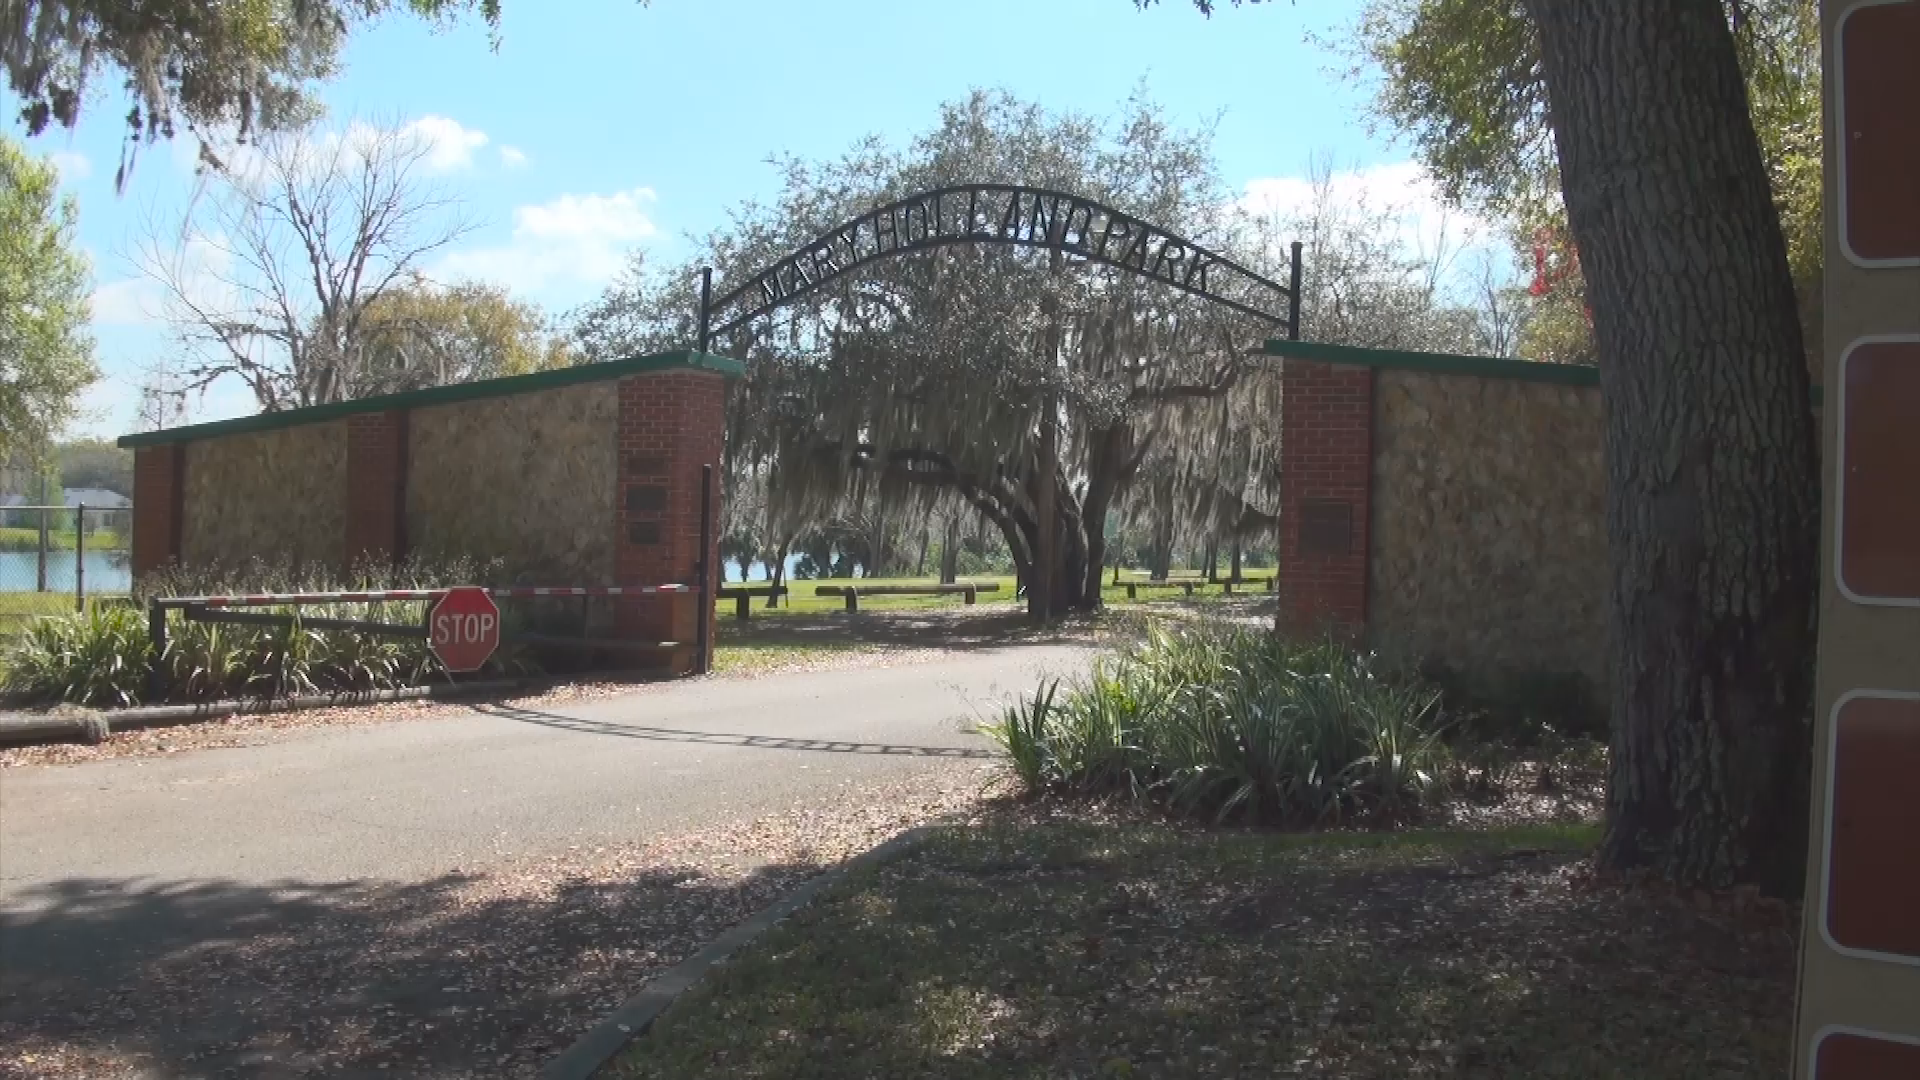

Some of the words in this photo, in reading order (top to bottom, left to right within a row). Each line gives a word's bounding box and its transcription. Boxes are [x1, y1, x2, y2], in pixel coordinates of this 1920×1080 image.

[760, 221, 860, 305] MARY
[874, 186, 1091, 252] HOLLAND
[1099, 214, 1217, 292] PARK
[435, 613, 494, 644] STOP
